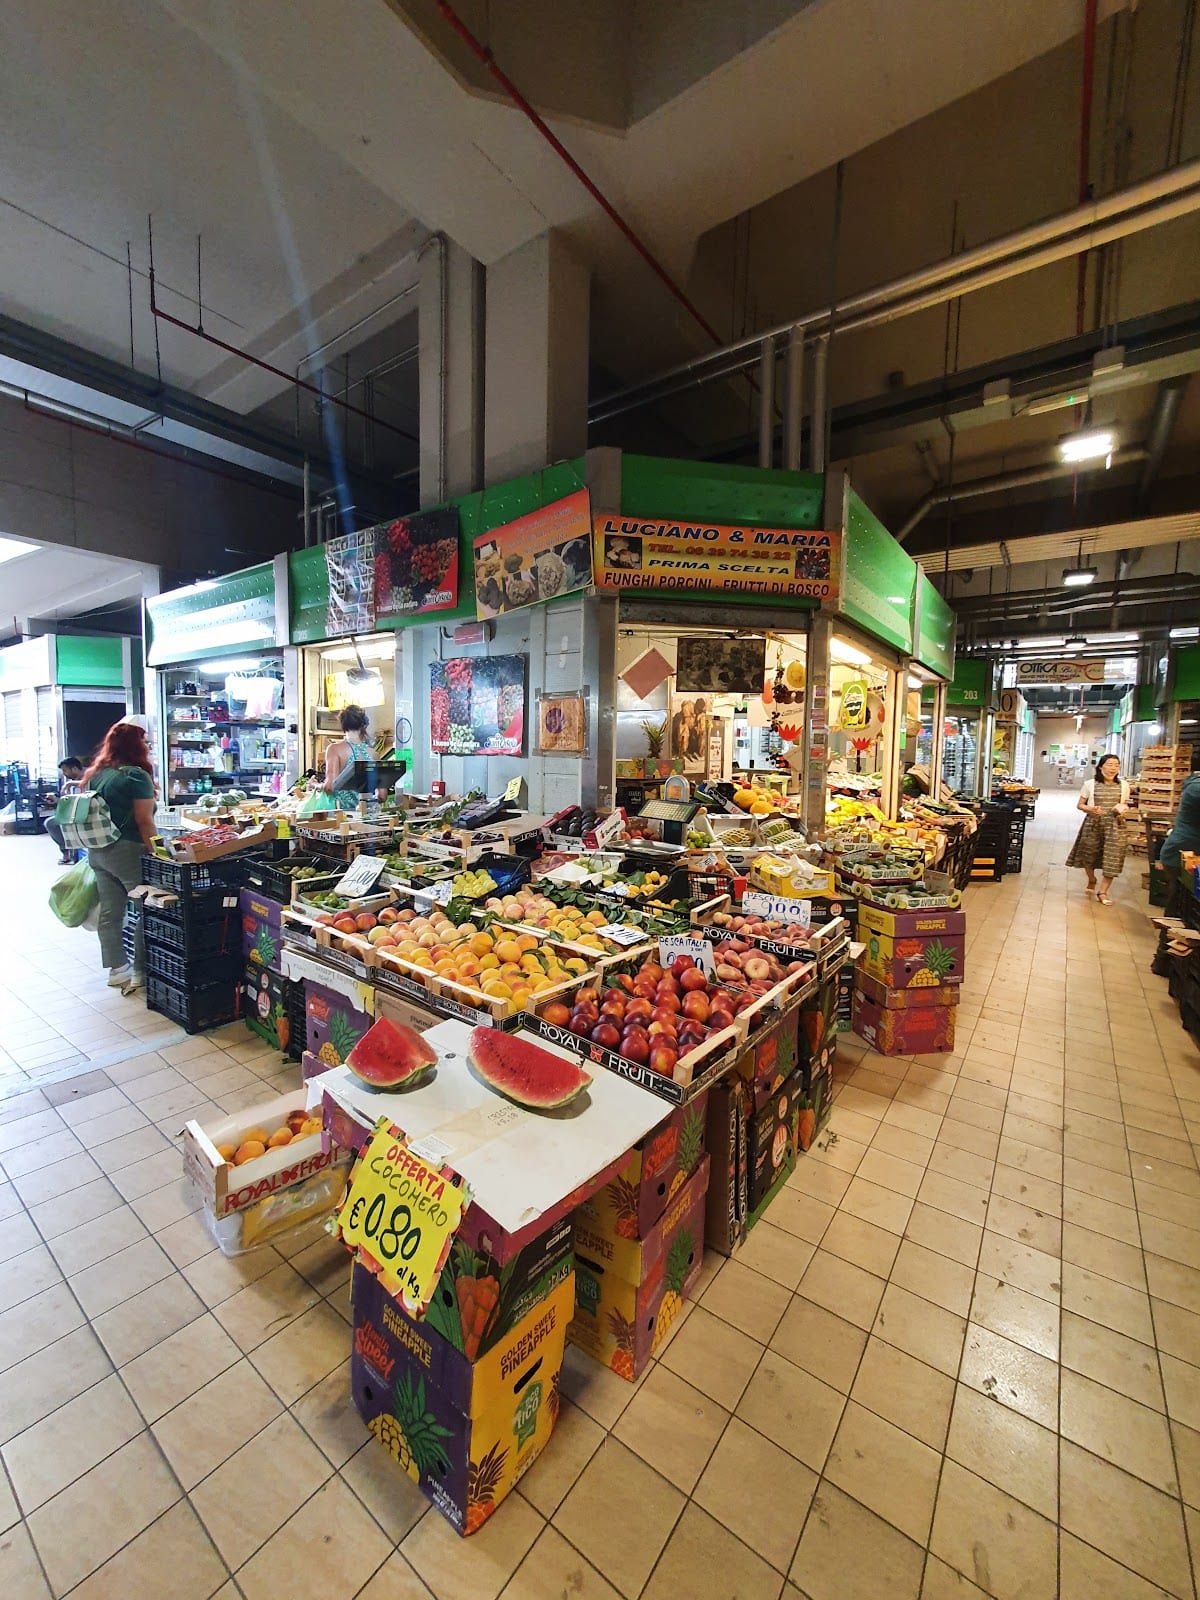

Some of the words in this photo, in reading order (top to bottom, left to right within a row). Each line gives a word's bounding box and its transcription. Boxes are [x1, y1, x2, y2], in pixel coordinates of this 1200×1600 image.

[604, 520, 720, 542] LUCIANO
[728, 530, 745, 543] &
[754, 532, 831, 547] MARIA
[685, 546, 704, 556] 06
[730, 548, 748, 558] 74
[751, 550, 770, 560] 35
[773, 551, 791, 561] 22
[648, 559, 710, 570] PRIMA
[717, 563, 790, 575] SCELTA
[604, 572, 655, 587] FUNGHI
[659, 575, 712, 590] PORCINI
[723, 579, 768, 593] FRUTTI
[771, 582, 783, 595] DI
[787, 584, 829, 597] BOSCO
[1020, 662, 1057, 673] OTTICA
[964, 690, 978, 700] 203
[883, 871, 909, 879] AVOCADOS
[747, 892, 775, 902] PESCA
[920, 897, 948, 907] AVOCADOS
[916, 923, 947, 931] PINEAPPLE
[659, 936, 684, 946] PESCA
[685, 937, 707, 948] ITALIA
[703, 927, 737, 940] ROYAL
[760, 940, 799, 957] FRUIT
[384, 971, 399, 983] ROYAL
[443, 999, 461, 1014] ROYAL
[539, 1021, 584, 1054] ROYAL
[608, 1054, 658, 1089] FRUIT
[387, 1145, 446, 1200] OFFERTA
[224, 1174, 281, 1213] ROYAL
[728, 1180, 736, 1224] FRUIT
[365, 1193, 421, 1261] 0.80
[396, 1266, 408, 1280] al
[383, 1303, 409, 1333] GOLDEN
[410, 1326, 432, 1355] SWEET
[501, 1330, 532, 1367] GOLDEN
[534, 1305, 556, 1335] SWEET
[382, 1312, 431, 1369] PINEAPPLE
[501, 1316, 556, 1380] PINEAPPLE
